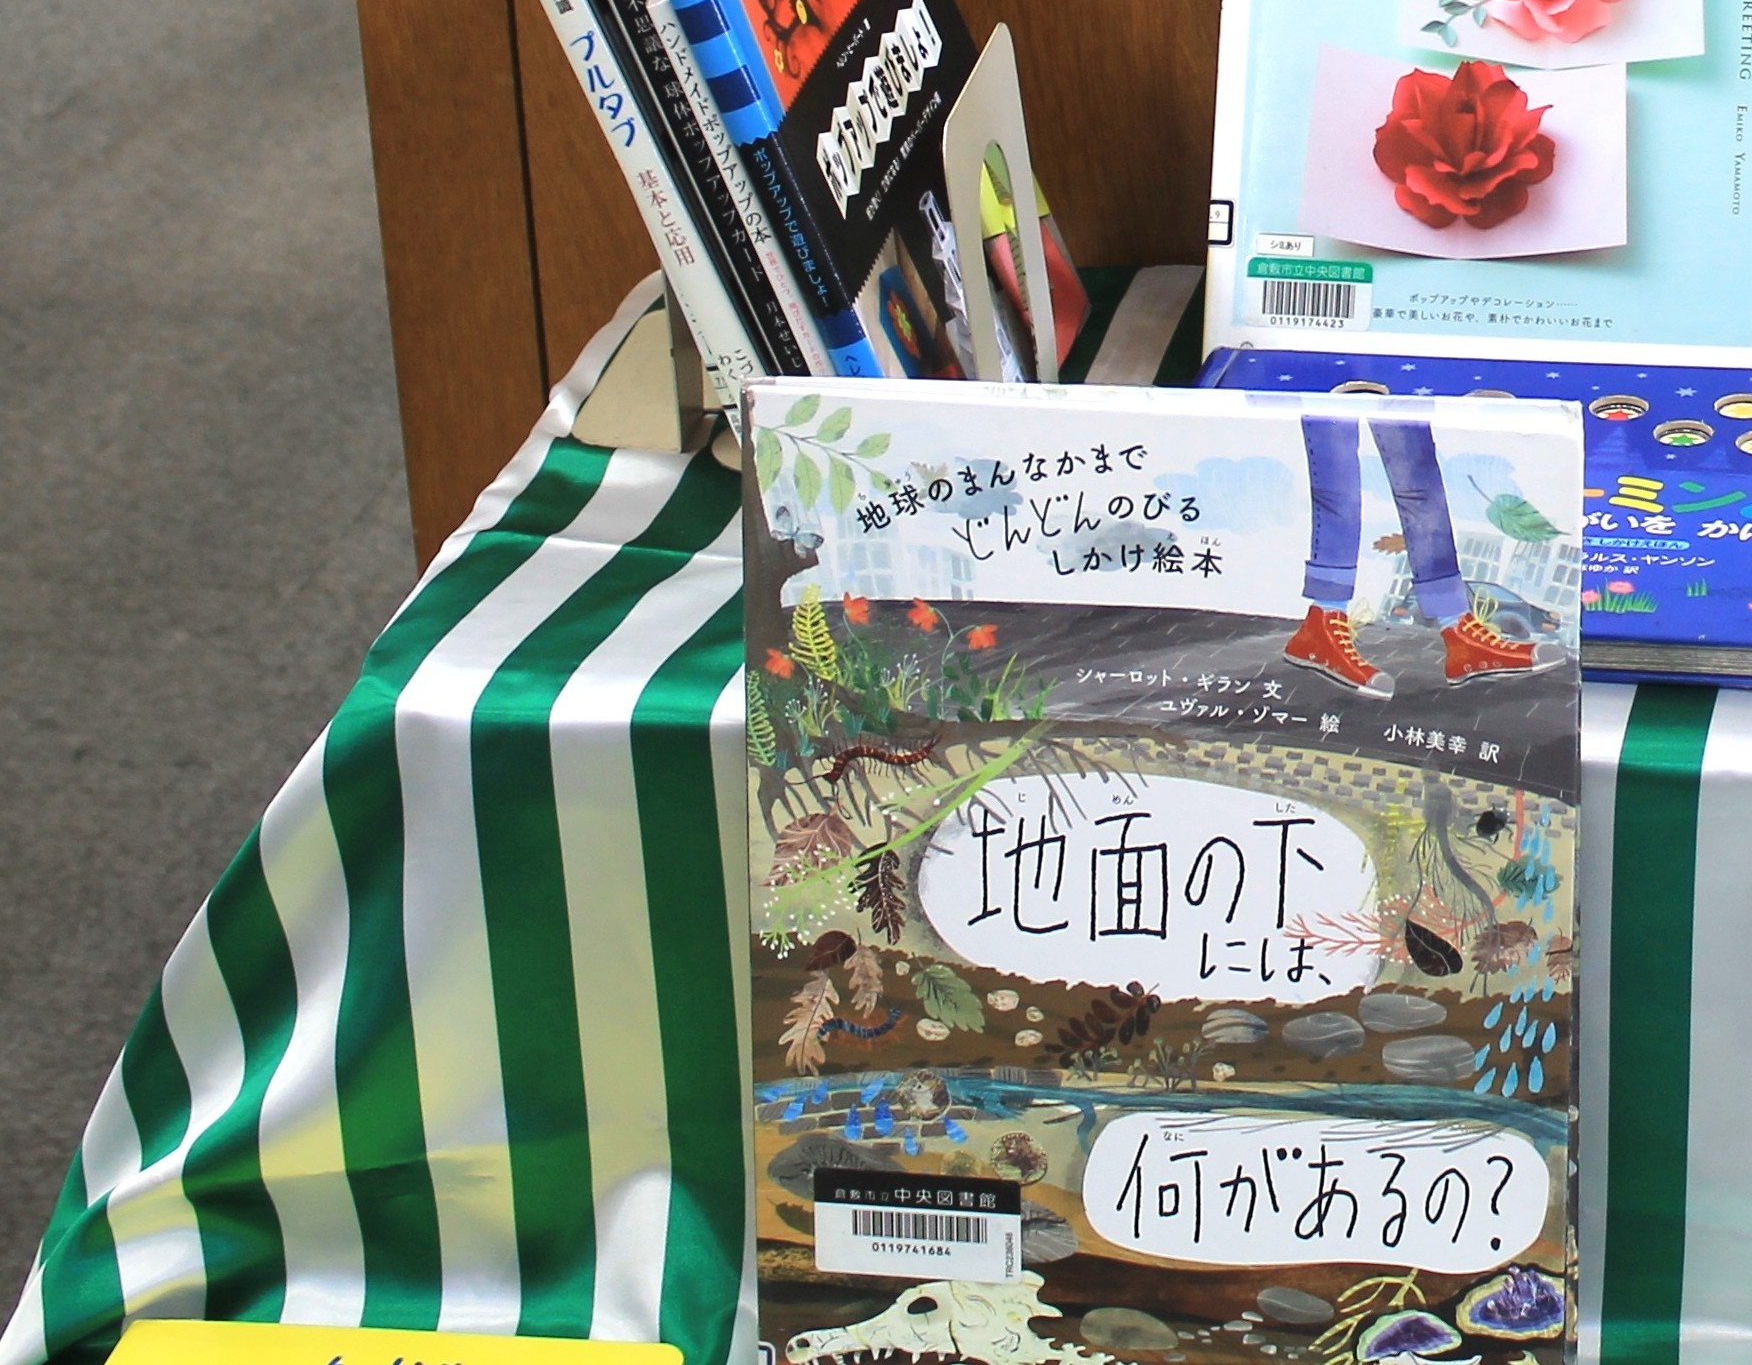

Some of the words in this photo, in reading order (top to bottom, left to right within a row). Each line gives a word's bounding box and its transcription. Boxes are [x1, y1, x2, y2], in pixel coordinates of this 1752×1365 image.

[569, 29, 638, 148] プルタブ
[821, 8, 938, 204] ポップアップで遊びましょ!
[659, 21, 772, 246] ハンドメイドポップアップの本
[636, 168, 696, 268] 基本と応用
[1270, 240, 1302, 252] シミあり
[1256, 262, 1366, 280] 倉敷市立中央図書館
[1270, 316, 1345, 329] 0119174423
[855, 443, 1148, 534] 地球のまんなかまで
[951, 490, 1201, 562] どんどんのびる
[1052, 542, 1223, 579] しかけ絵本
[1623, 565, 1640, 575] 訳
[1075, 667, 1252, 696] シャーロット・ギラン
[1263, 679, 1284, 701] 文
[1160, 697, 1309, 726] ユヴァル・ゾマー
[1319, 712, 1341, 734] 絵
[1383, 722, 1468, 756] 小林美幸
[1478, 740, 1501, 764] 訳
[967, 806, 1325, 942] 地面の下
[1198, 932, 1332, 986] には、
[1115, 1133, 1515, 1253] 何があるの?
[871, 1241, 952, 1256] 0119741684
